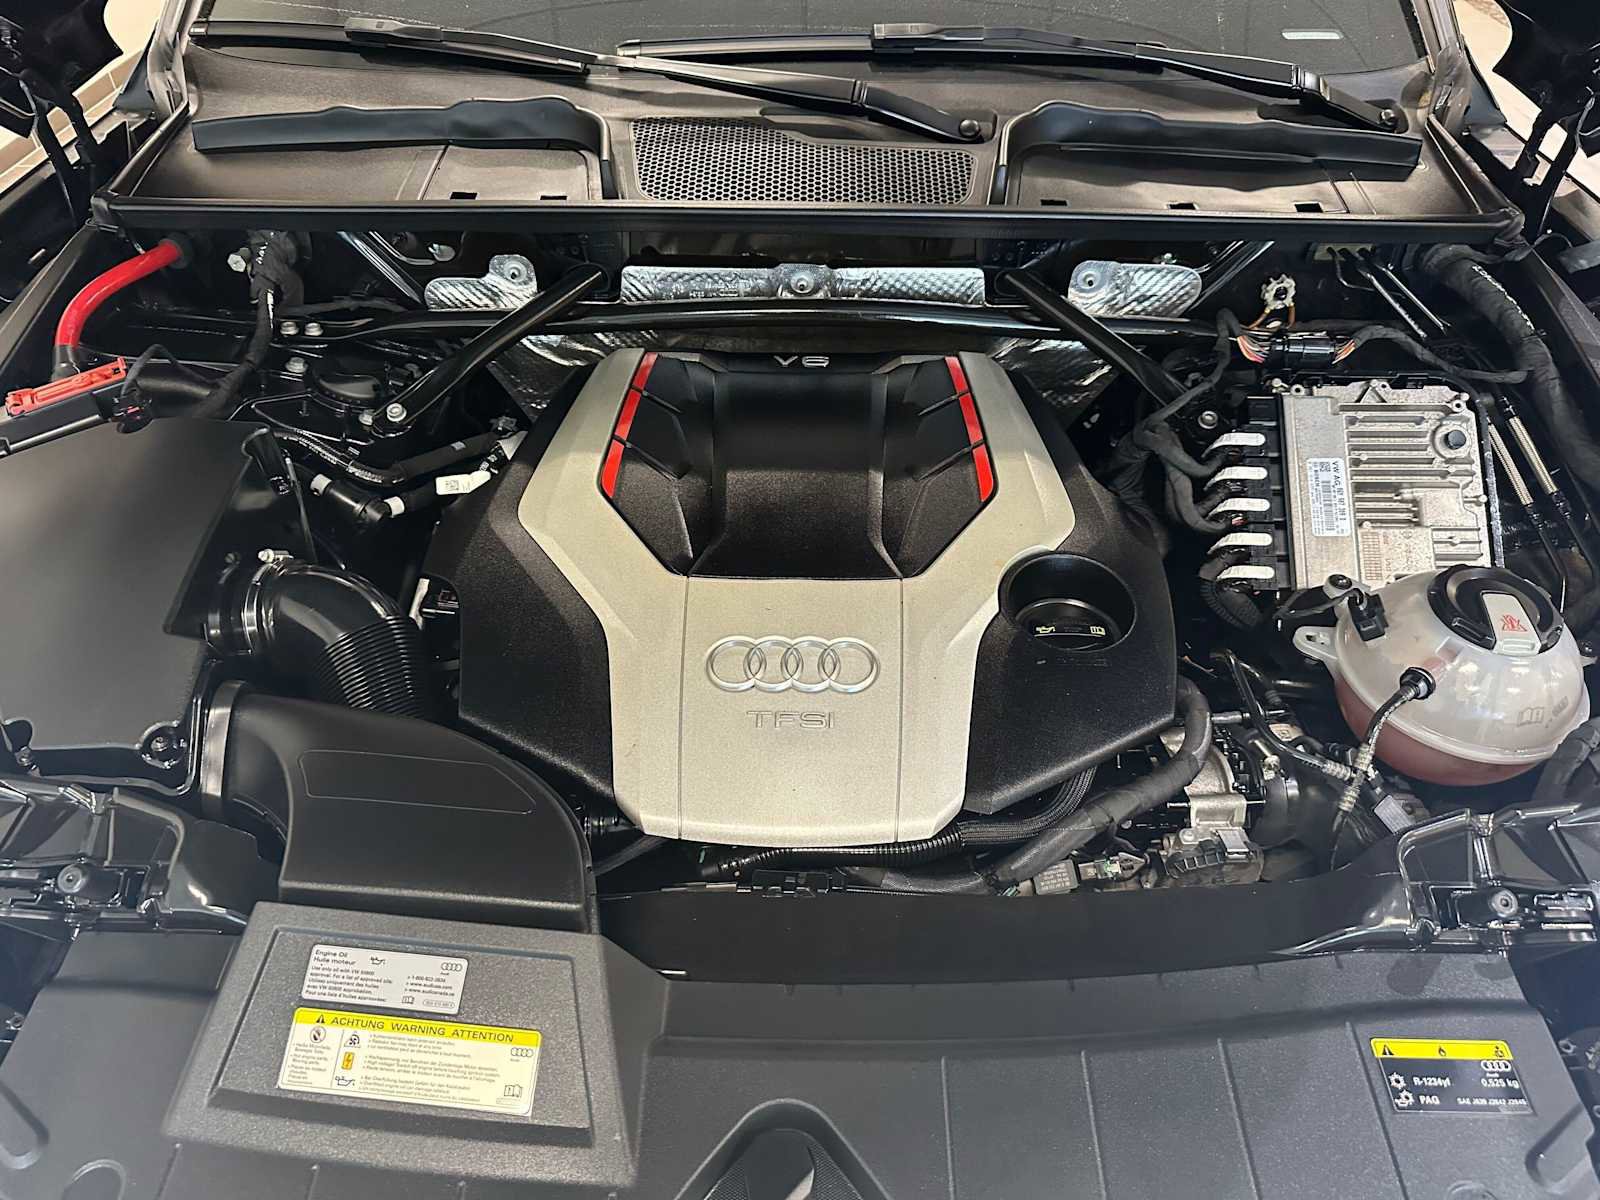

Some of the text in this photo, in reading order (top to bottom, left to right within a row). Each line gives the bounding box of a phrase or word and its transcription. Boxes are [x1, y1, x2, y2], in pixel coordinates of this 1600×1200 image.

[774, 355, 830, 368] V6
[1333, 461, 1340, 473] VW
[1334, 475, 1341, 485] AG
[746, 710, 835, 729] TFSI
[315, 949, 337, 957] Engine
[331, 1016, 384, 1030] ACHTUNG
[391, 1022, 446, 1036] WARNING
[452, 1029, 514, 1042] ATTENTION
[1507, 1079, 1519, 1089] kg
[1419, 1095, 1440, 1105] PAG
